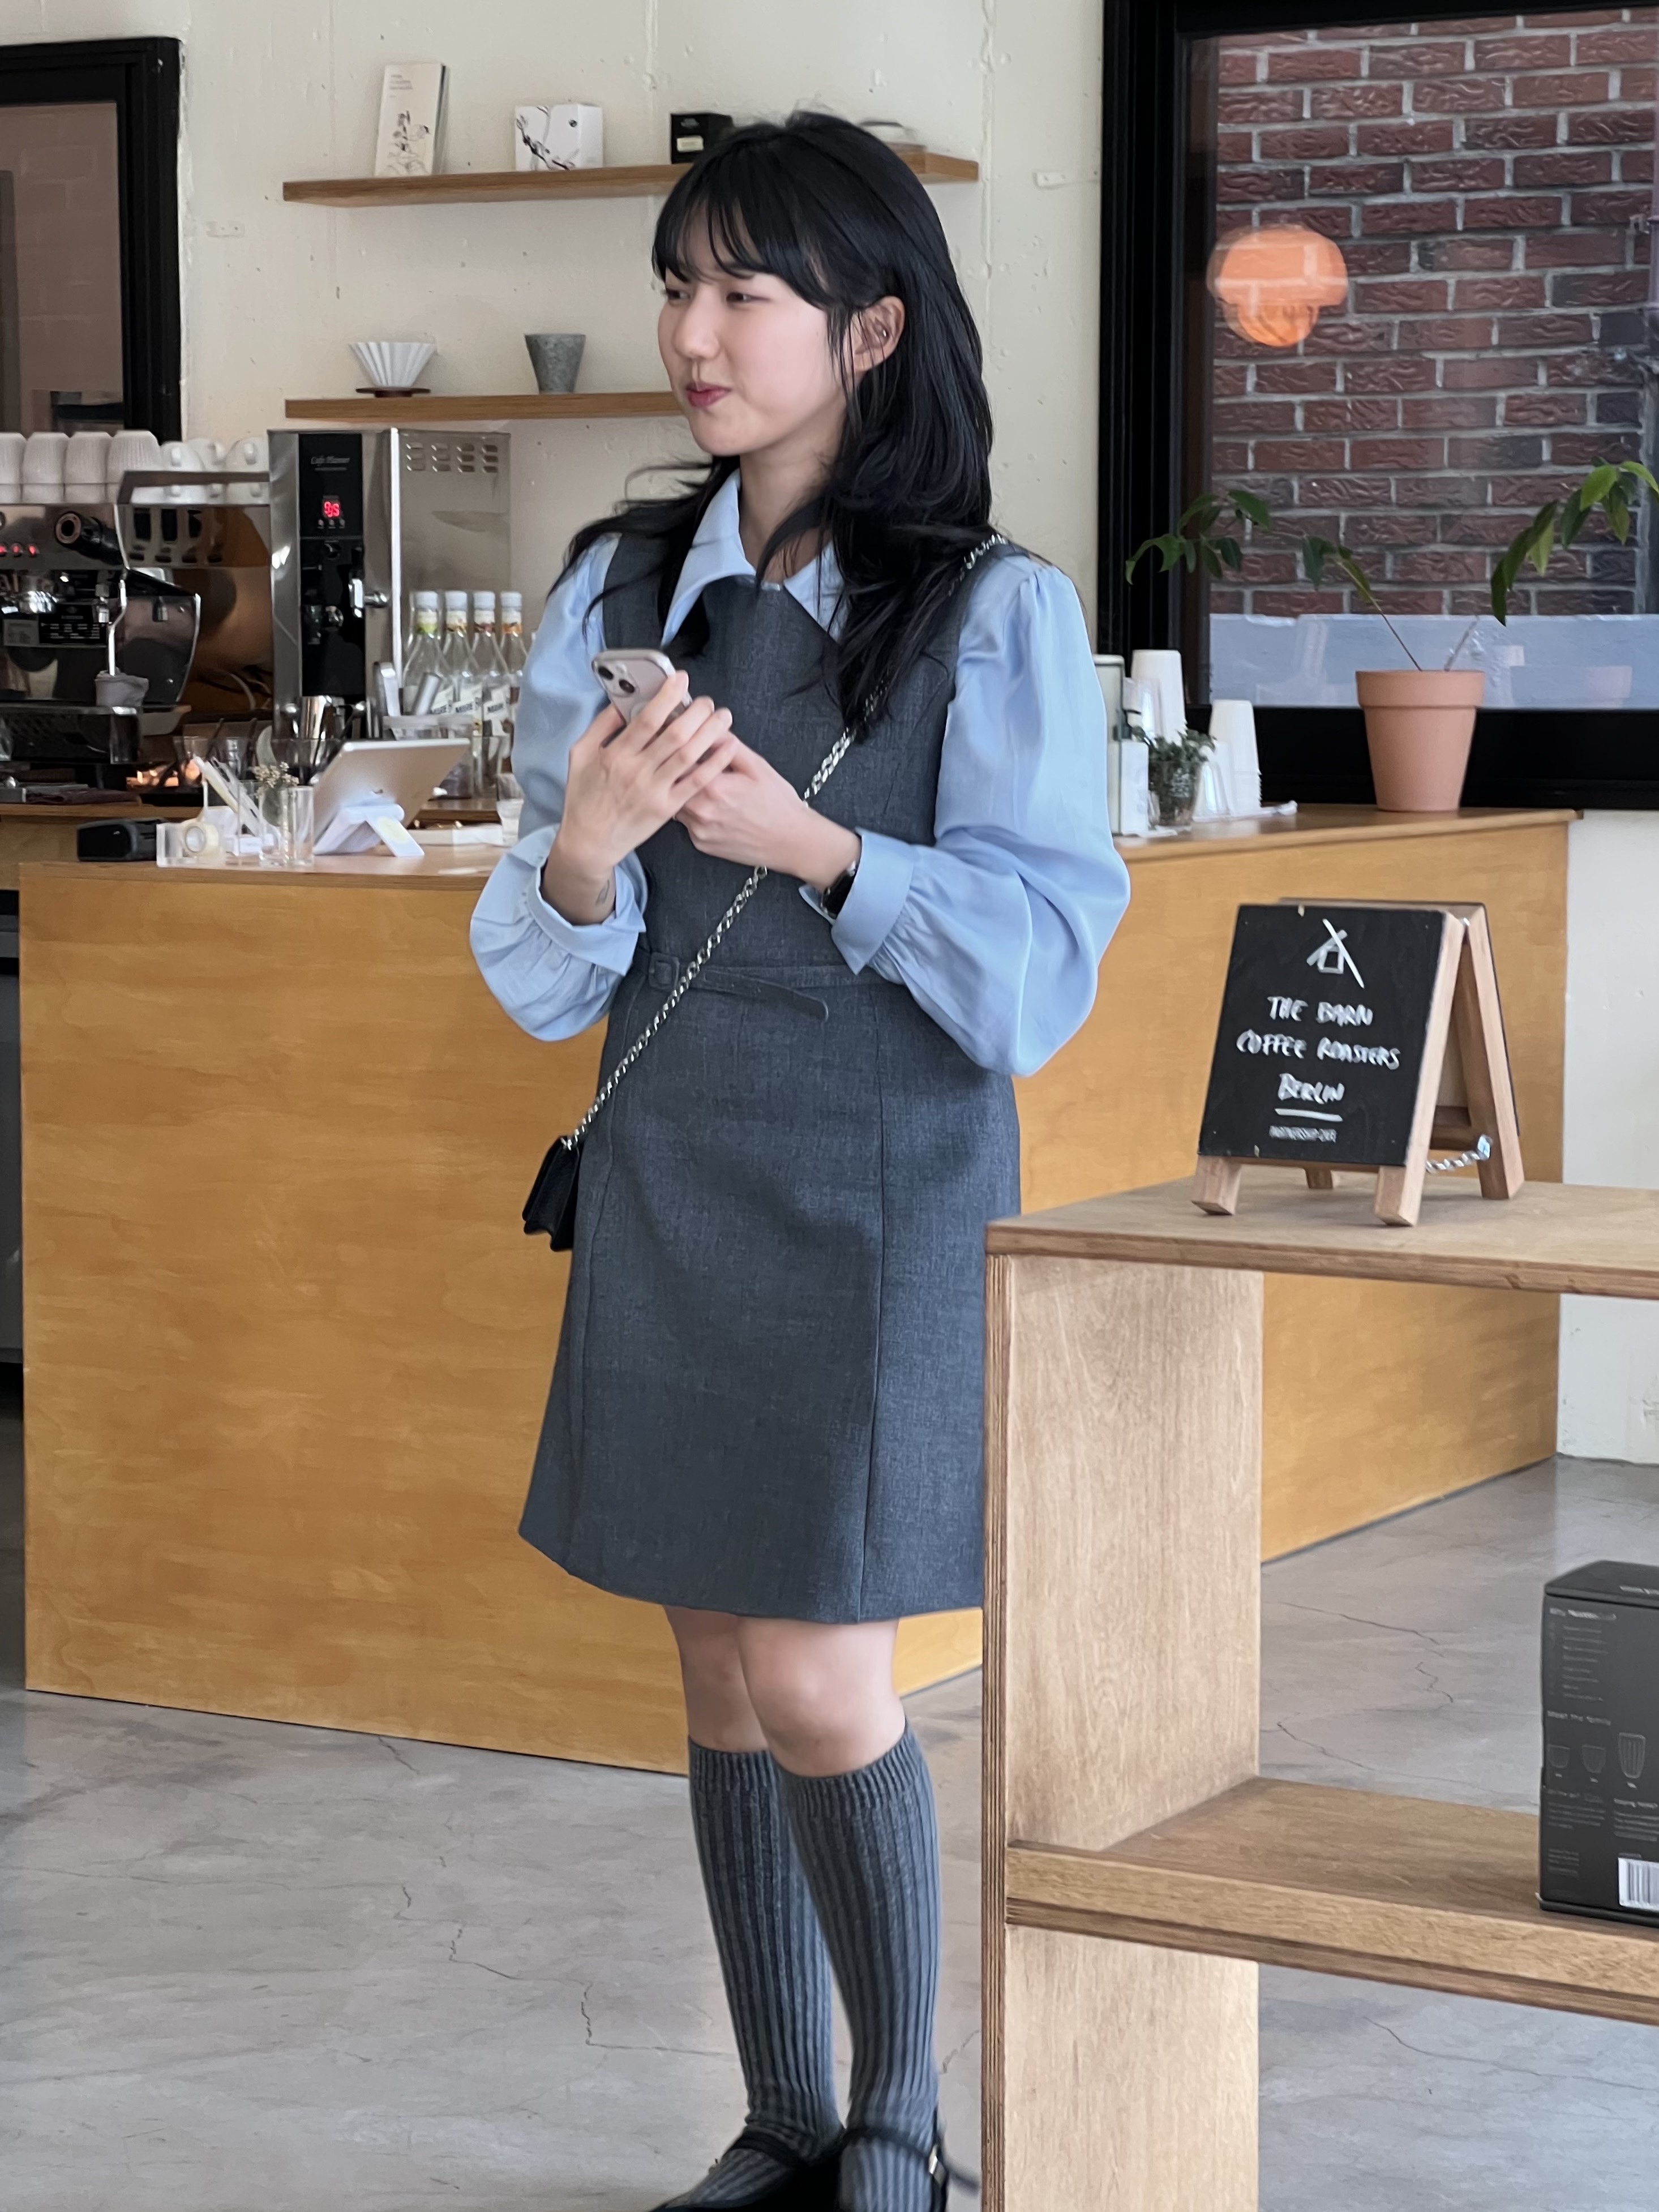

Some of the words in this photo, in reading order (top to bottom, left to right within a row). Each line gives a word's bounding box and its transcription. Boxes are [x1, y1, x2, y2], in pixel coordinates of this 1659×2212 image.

[1267, 996, 1309, 1022] THE
[1315, 1001, 1374, 1027] BARN
[1236, 1028, 1308, 1059] COFFEE
[1316, 1036, 1401, 1070] ROASTERS
[1278, 1073, 1345, 1105] BERLIN
